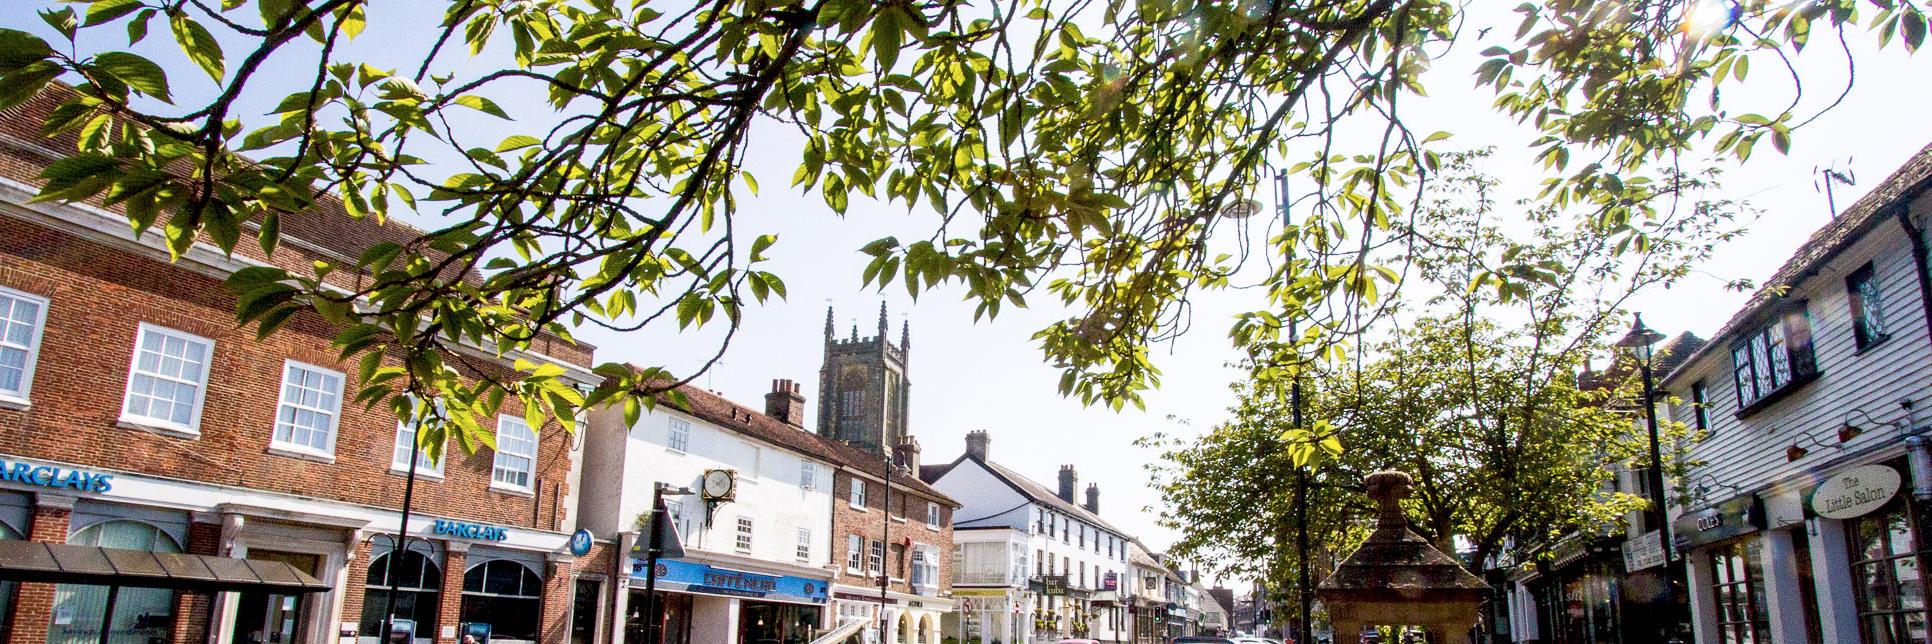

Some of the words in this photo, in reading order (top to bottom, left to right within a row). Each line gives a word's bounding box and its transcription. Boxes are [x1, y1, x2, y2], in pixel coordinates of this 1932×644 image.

[1843, 477, 1859, 490] The
[1825, 495, 1852, 513] Little
[1854, 487, 1886, 506] Salon
[1697, 512, 1719, 531] COLES
[434, 519, 509, 541] BARCLAYS
[744, 577, 777, 591] NERO
[1046, 577, 1058, 585] bar
